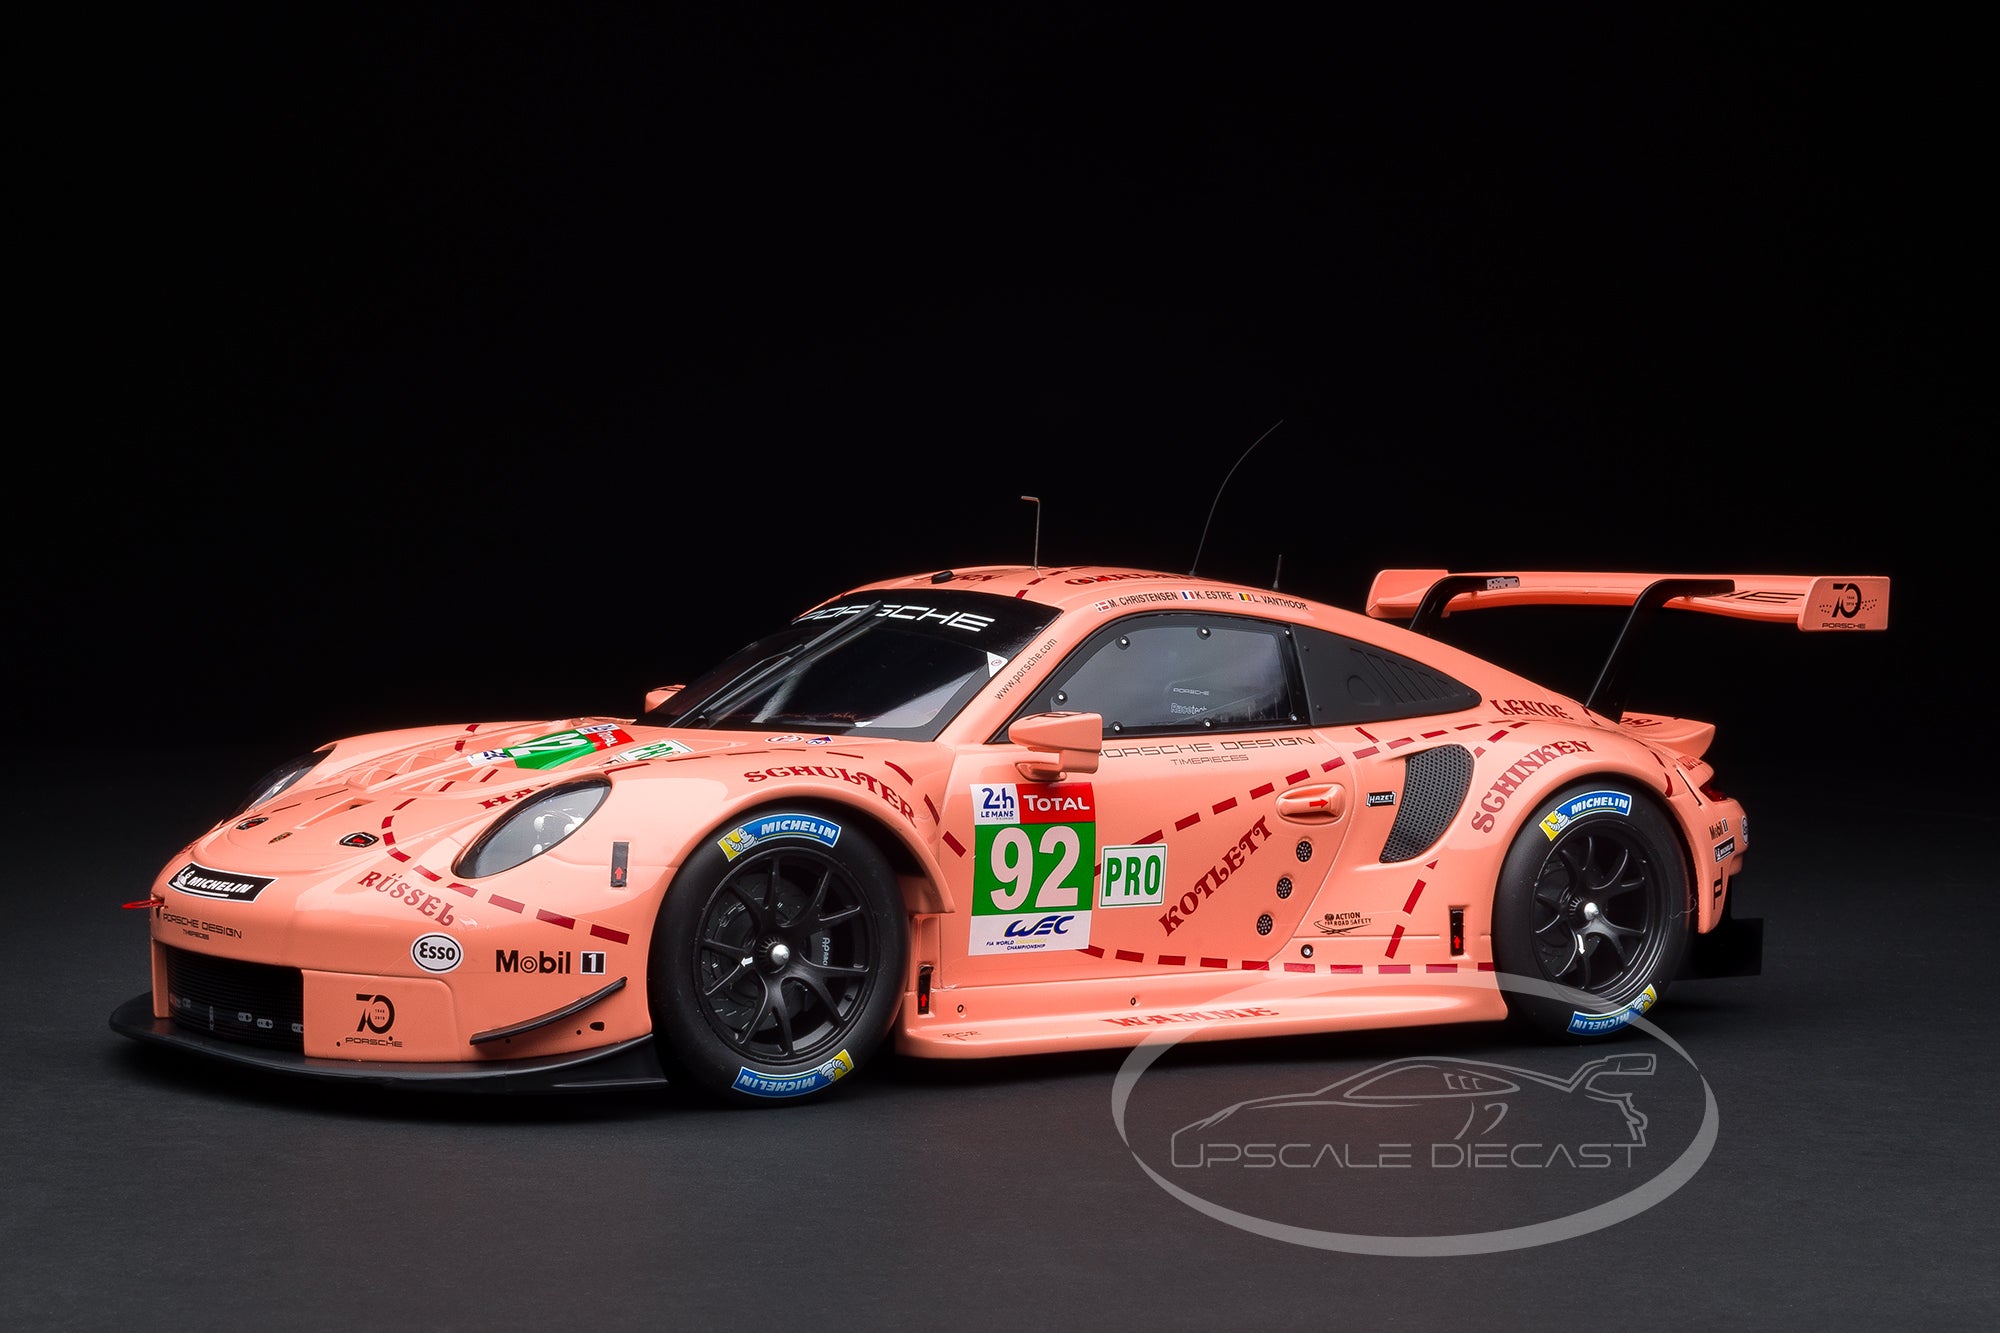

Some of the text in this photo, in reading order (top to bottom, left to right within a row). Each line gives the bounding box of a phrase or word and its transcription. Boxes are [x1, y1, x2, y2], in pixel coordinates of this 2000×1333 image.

[1109, 591, 1178, 608] M. CHRISTENSEN
[1196, 590, 1234, 601] K. ESTRE
[1261, 596, 1308, 611] VANTHOOR
[1832, 583, 1862, 618] 70
[994, 637, 1057, 701] www.porsche.com
[1098, 736, 1316, 758] ORSCHE DESIGN
[1170, 754, 1249, 766] TIMEPIECES
[743, 765, 917, 828] SCHULTER
[1471, 739, 1595, 834] SCHINKEN
[981, 787, 1015, 809] 24h
[1023, 794, 1090, 812] TOTAL
[1370, 794, 1394, 803] HAZET
[1571, 796, 1629, 815] MICHELIN
[760, 819, 836, 838] MICHELIN
[990, 825, 1080, 911] 92
[1105, 855, 1161, 897] PRO
[1158, 815, 1273, 937] KOTLETT
[187, 876, 254, 894] MICHELIN
[357, 870, 454, 927] RÜSSEL
[163, 913, 242, 939] PORSCHE DESIGN
[1004, 915, 1075, 937] WEC
[1335, 912, 1361, 920] ACTION
[495, 949, 571, 974] Mobil
[356, 993, 395, 1034] 70
[1573, 1011, 1630, 1030] MICHELIN
[345, 1037, 403, 1048] PORSCHE
[738, 1076, 816, 1093] MICHELIN
